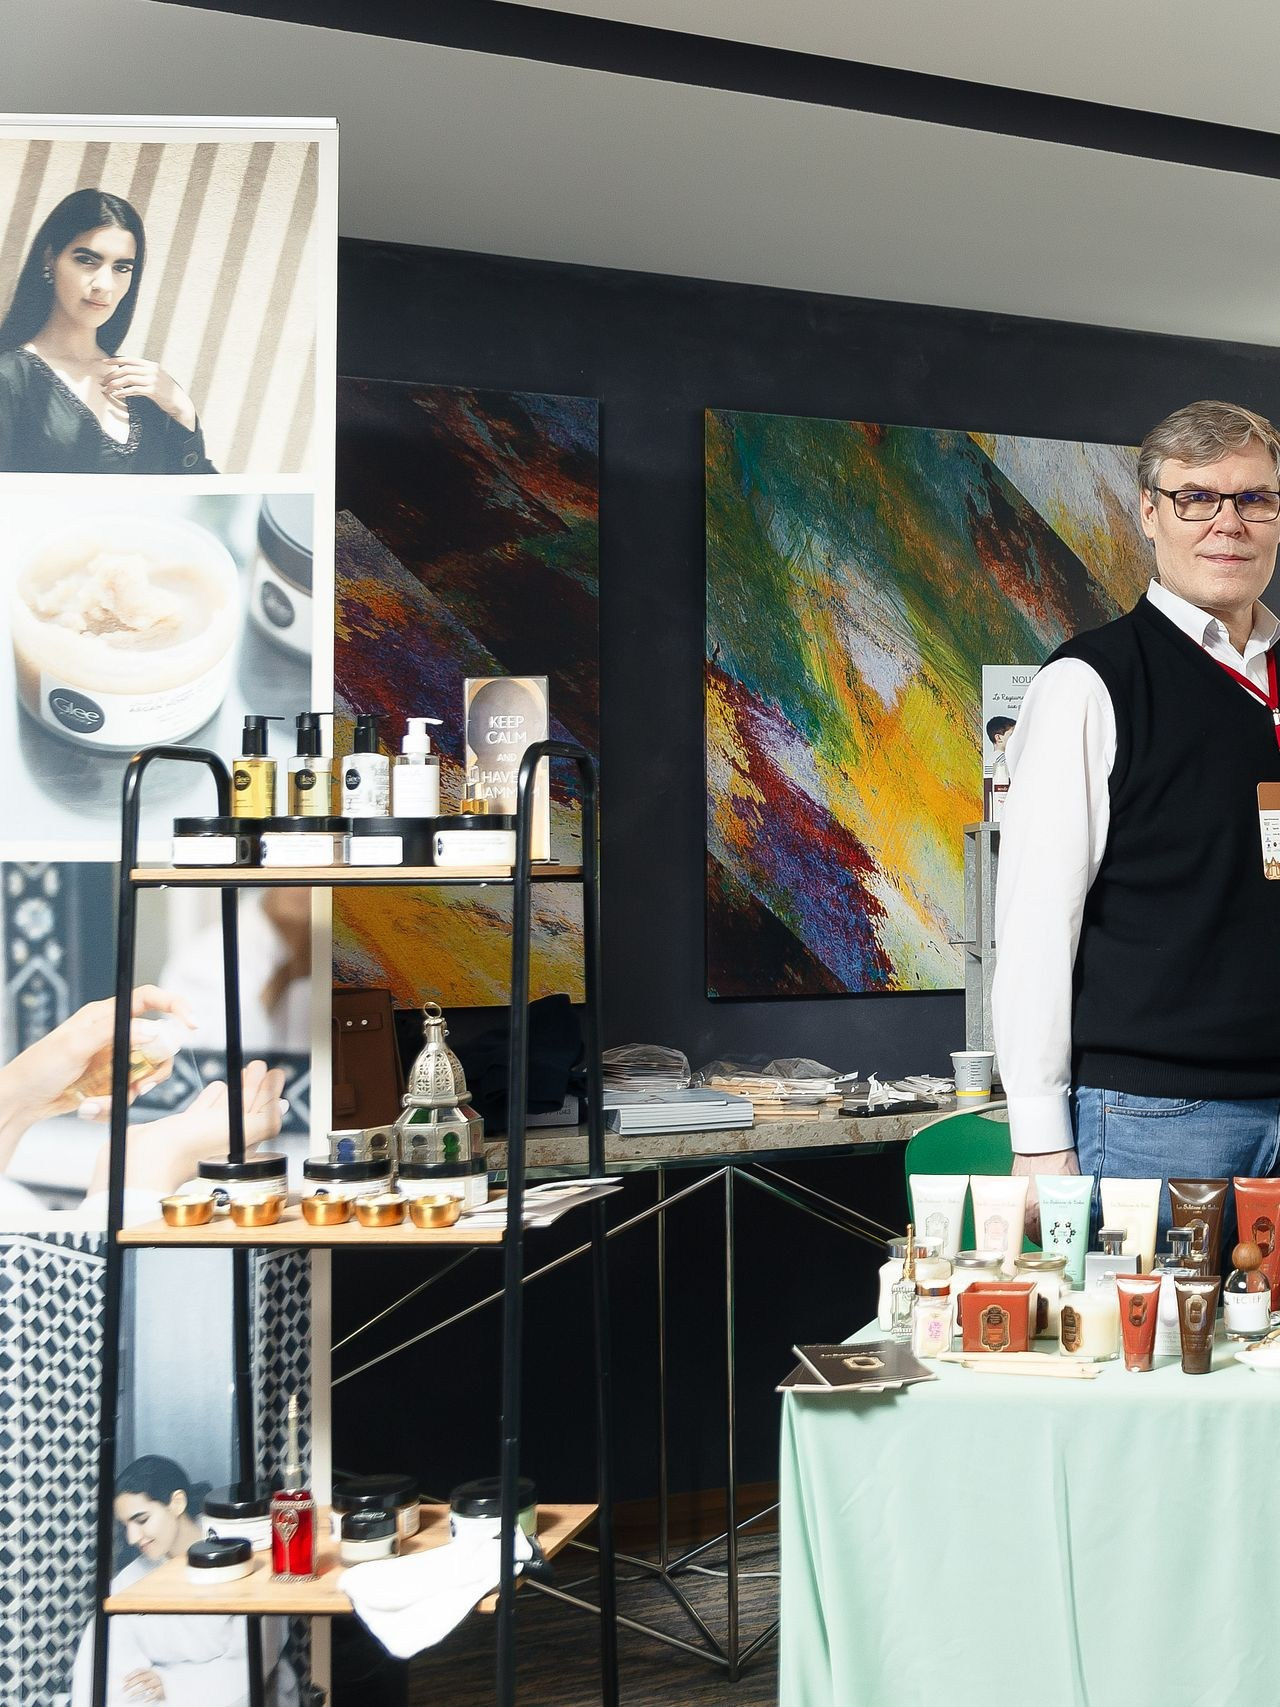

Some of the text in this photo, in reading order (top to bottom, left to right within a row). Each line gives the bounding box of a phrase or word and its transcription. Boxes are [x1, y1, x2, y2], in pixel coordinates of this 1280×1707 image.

[1011, 676, 1031, 684] NOU
[489, 715, 525, 728] KEEP
[487, 730, 527, 744] CALM
[481, 770, 520, 783] HAVE
